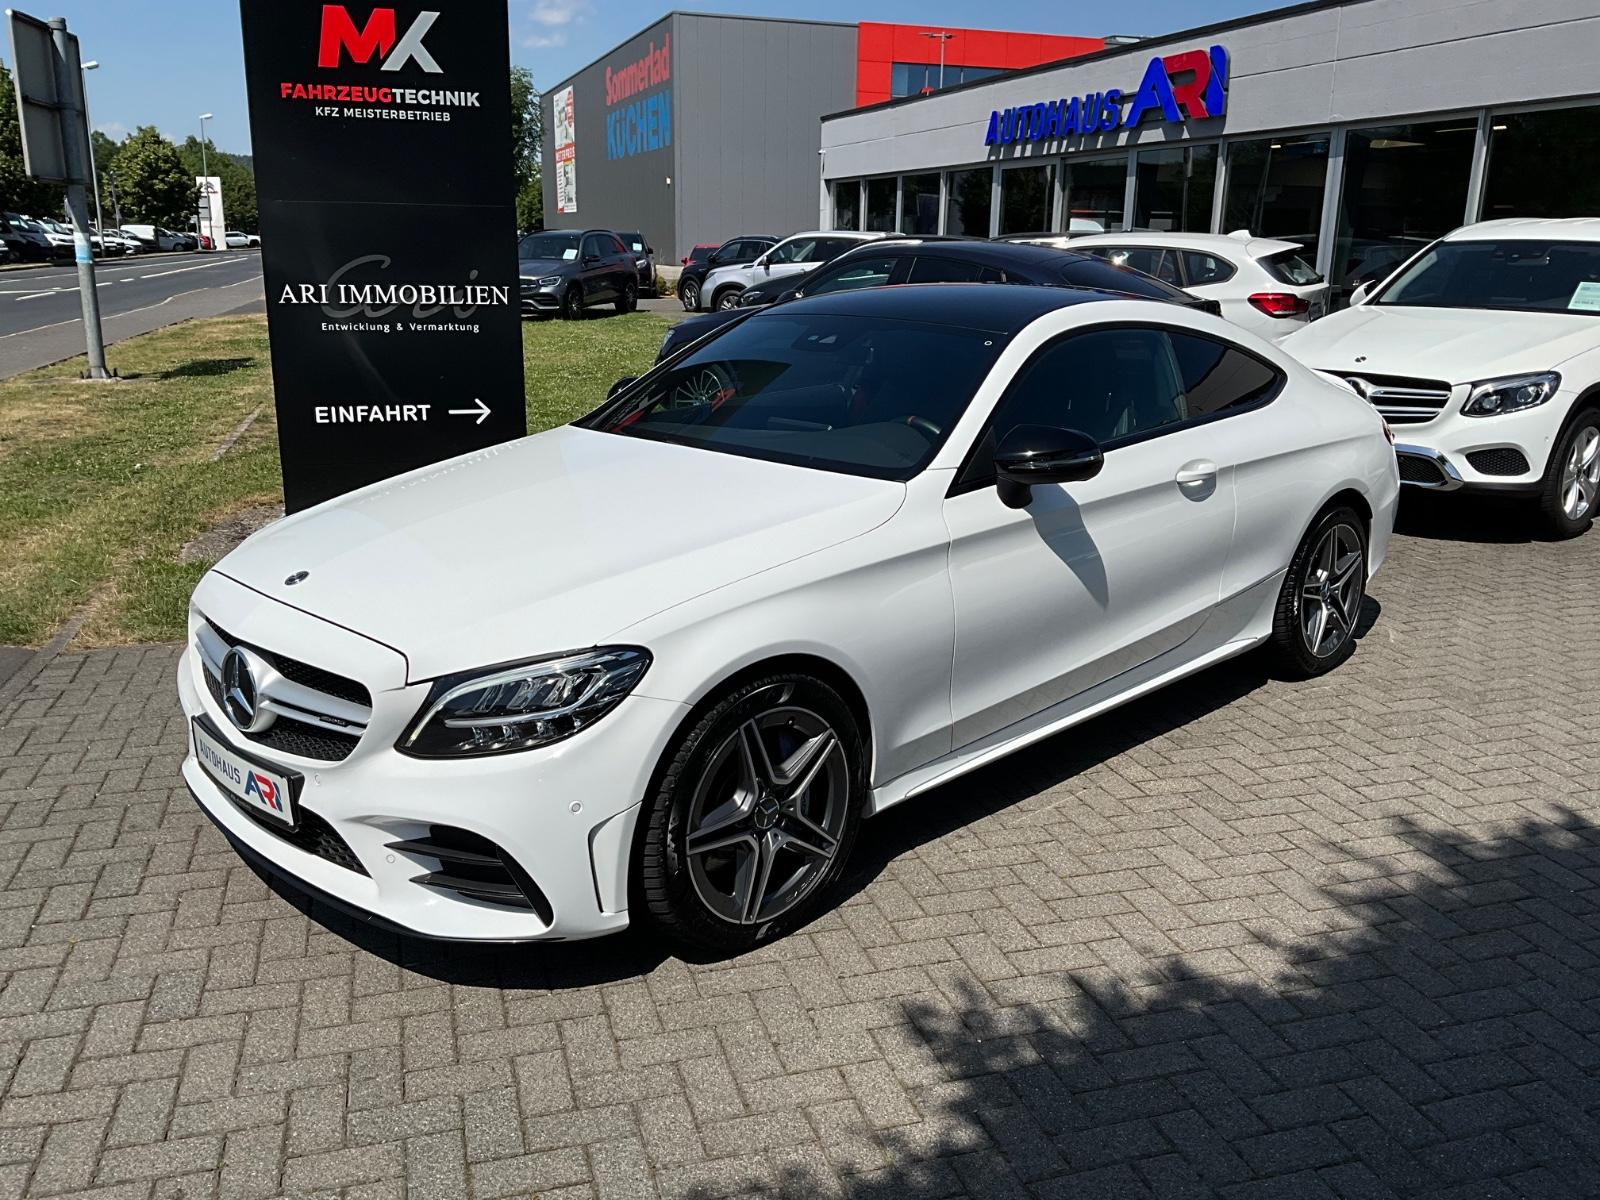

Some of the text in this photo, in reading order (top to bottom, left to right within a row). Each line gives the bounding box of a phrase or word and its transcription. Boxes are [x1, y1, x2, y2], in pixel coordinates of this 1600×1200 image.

[318, 4, 444, 73] MK
[605, 32, 670, 106] Sommerlad
[280, 82, 481, 107] FAHRZEUGTECHNIK
[315, 106, 451, 122] KFZ MEISTERBETRIEB
[985, 45, 1229, 146] AUTOHAUS ARI
[607, 89, 671, 160] KÜCHEN
[278, 283, 510, 305] ARI IMMOBILIEN
[321, 322, 480, 334] Entwicklung & Vermarktung
[314, 404, 431, 424] EINFAHRT
[200, 739, 241, 785] AUTOHAUS
[244, 769, 284, 813] ARI
